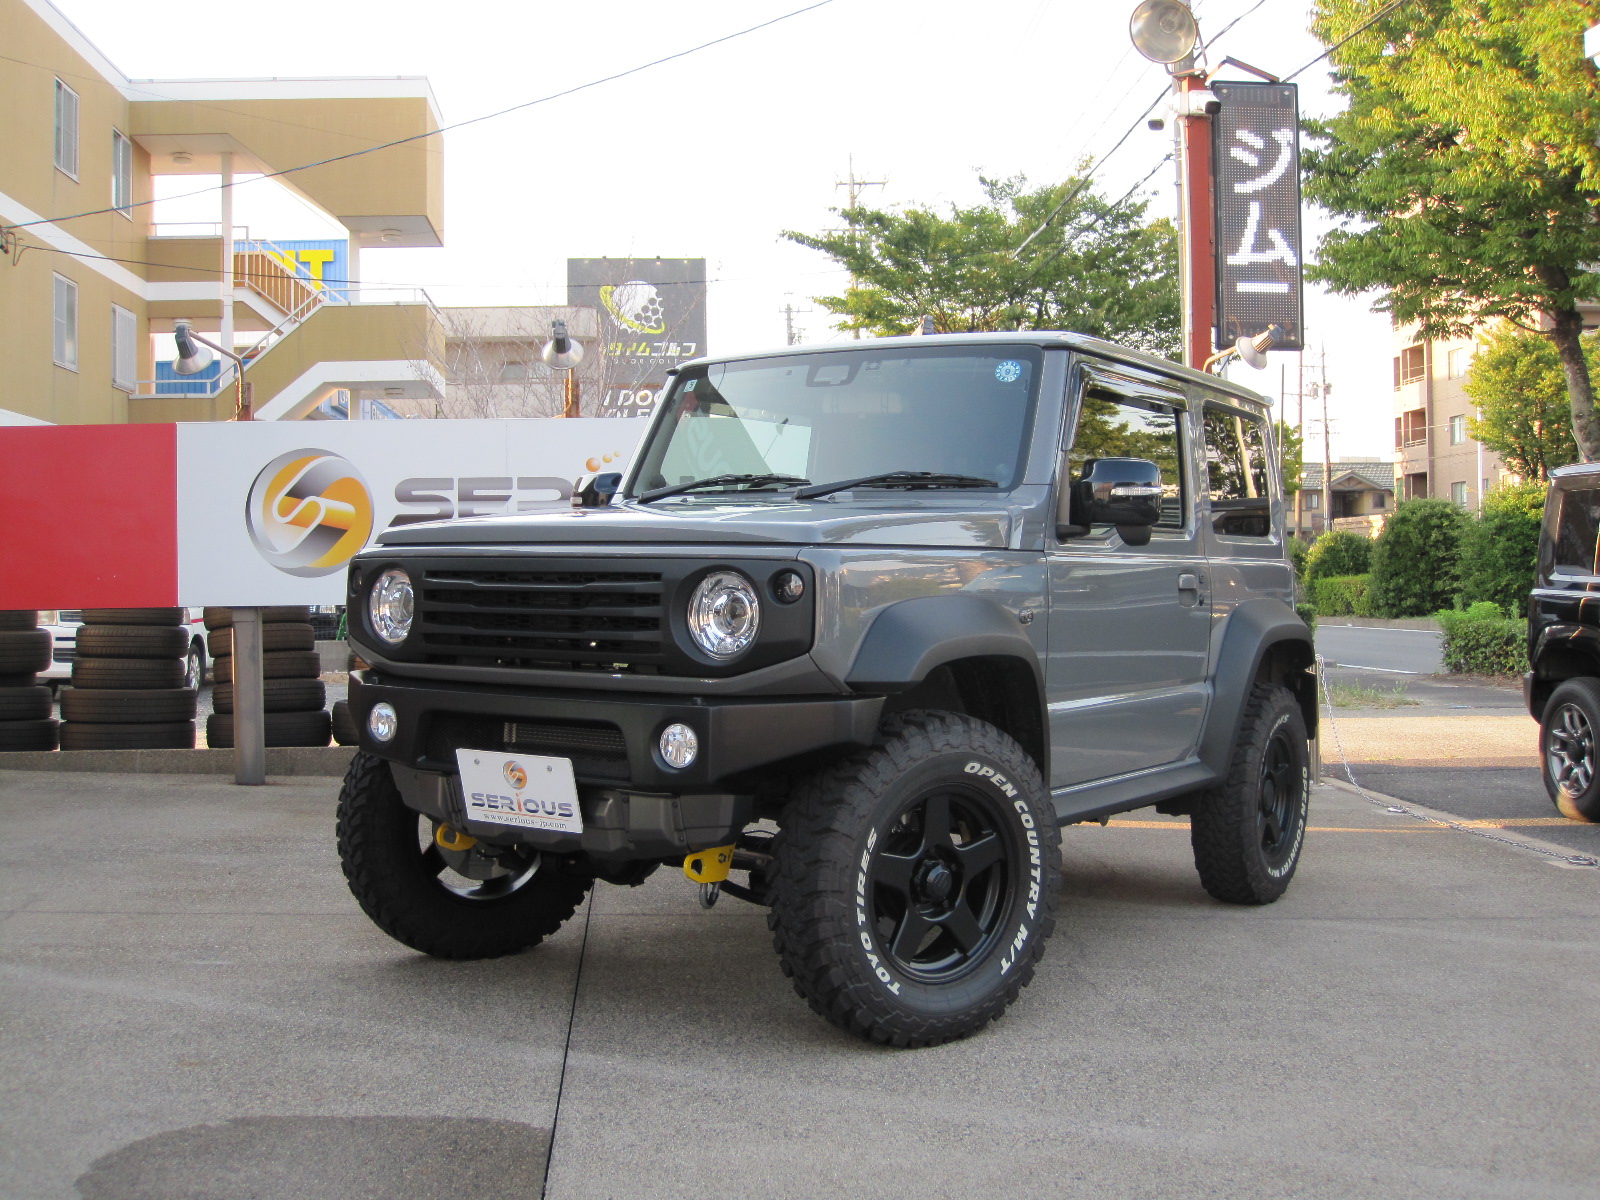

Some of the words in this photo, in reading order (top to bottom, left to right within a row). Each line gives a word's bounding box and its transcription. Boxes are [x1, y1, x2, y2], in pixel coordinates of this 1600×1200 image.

[964, 762, 1018, 798] OPEN
[484, 813, 567, 829] www.serious-jp.com
[856, 827, 878, 926] TIRES
[1013, 800, 1042, 921] COUNTRY
[860, 931, 901, 996] TOYO
[1000, 923, 1029, 976] M/T
